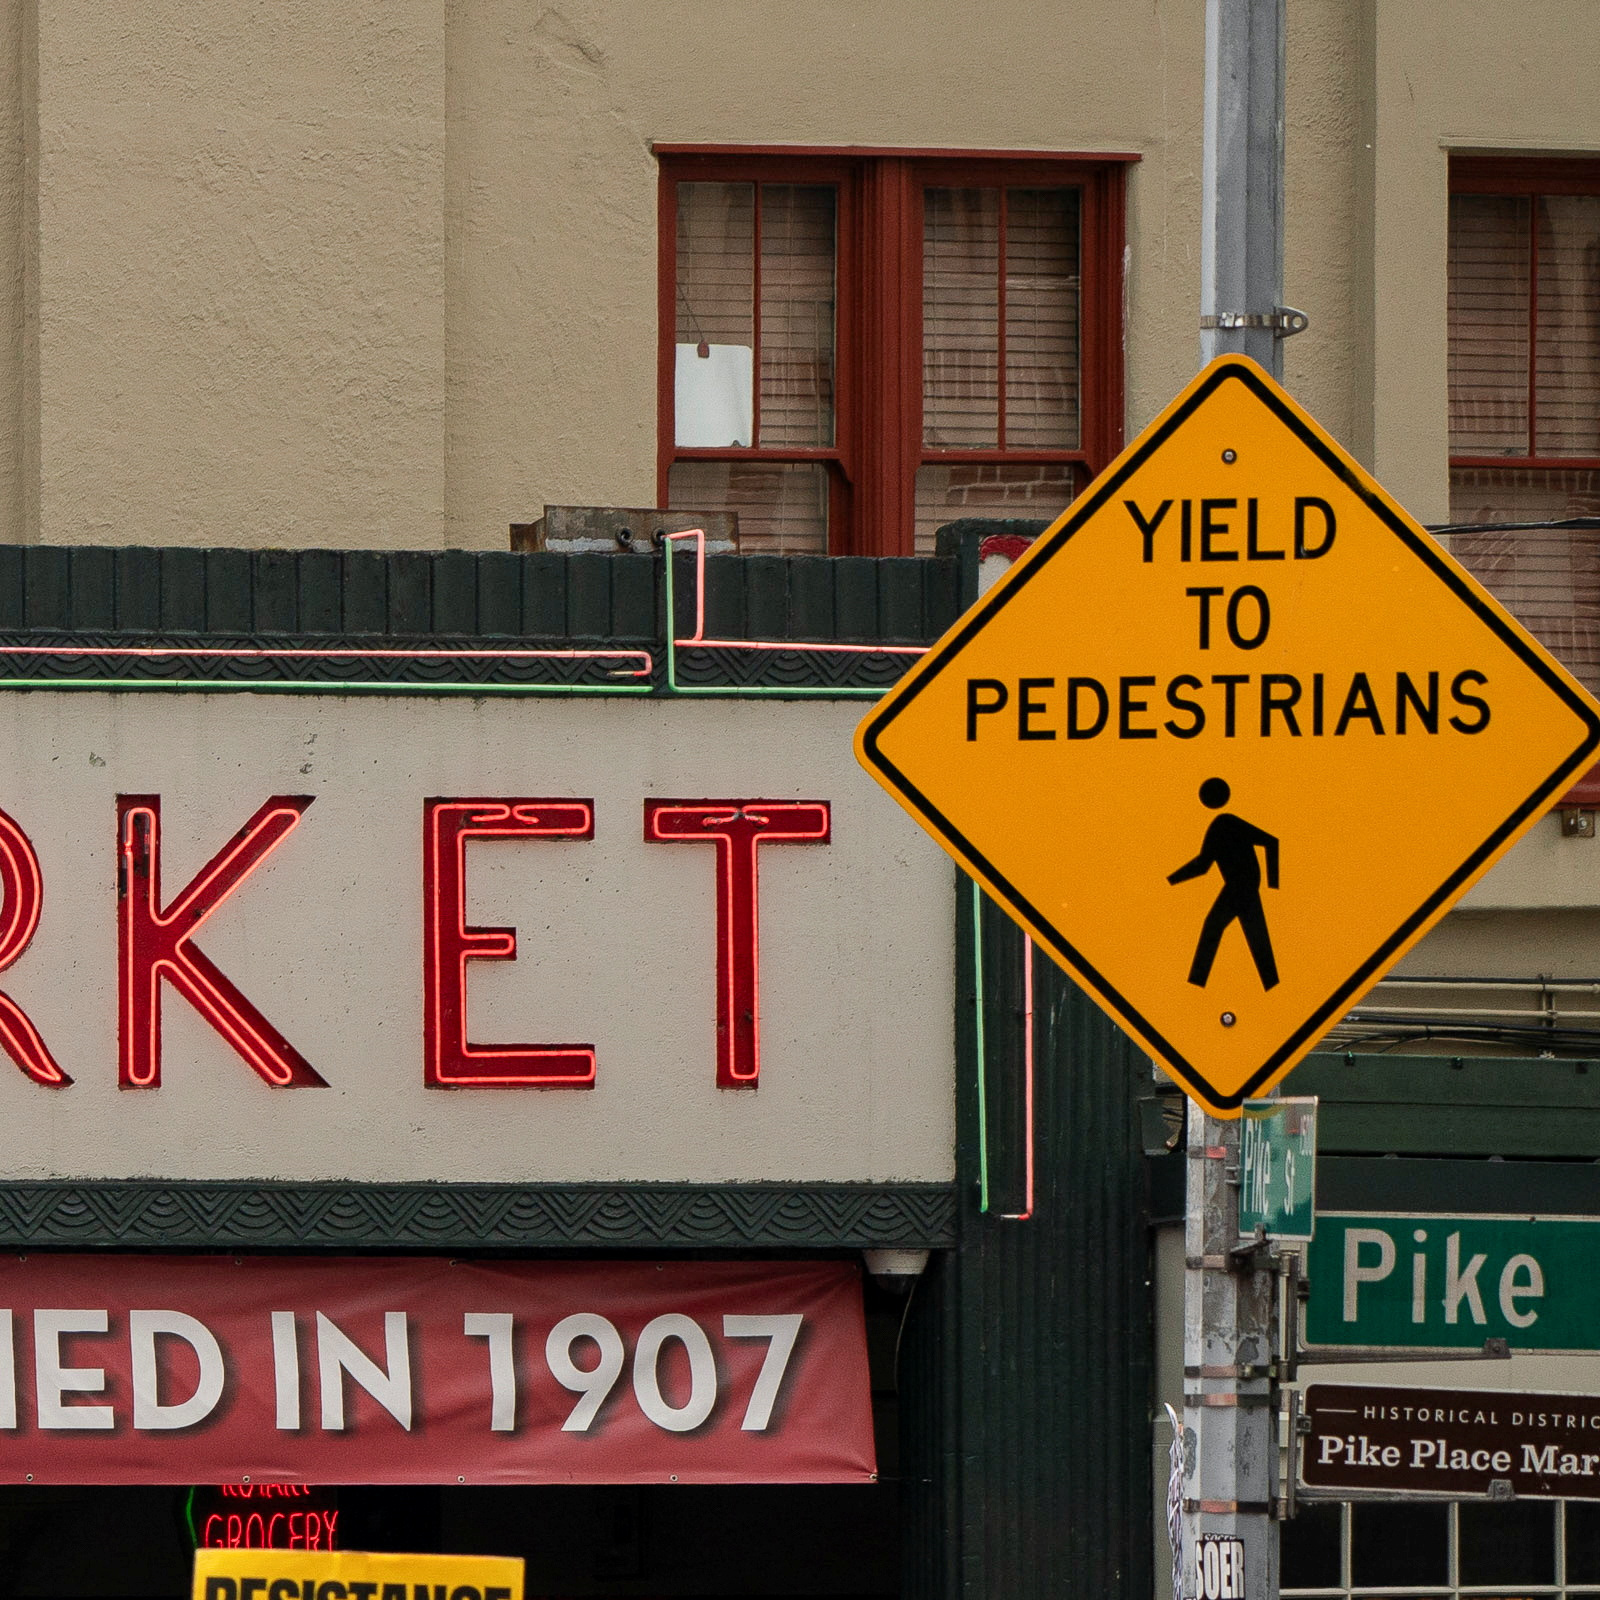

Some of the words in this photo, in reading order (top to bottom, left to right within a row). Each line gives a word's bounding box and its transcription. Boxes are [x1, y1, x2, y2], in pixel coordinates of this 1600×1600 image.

[1123, 496, 1337, 563] YIELD
[1185, 584, 1272, 651] TO
[965, 669, 1493, 742] PEDESTRIANS
[1343, 1227, 1545, 1328] Pike
[272, 1312, 413, 1433] IN
[462, 1311, 803, 1434] 1907
[1363, 1405, 1498, 1425] HISTORICAL
[1317, 1435, 1401, 1467] Pike
[1409, 1439, 1512, 1472] Place
[1519, 1444, 1600, 1476] Mar
[205, 1510, 338, 1552] GROCERY
